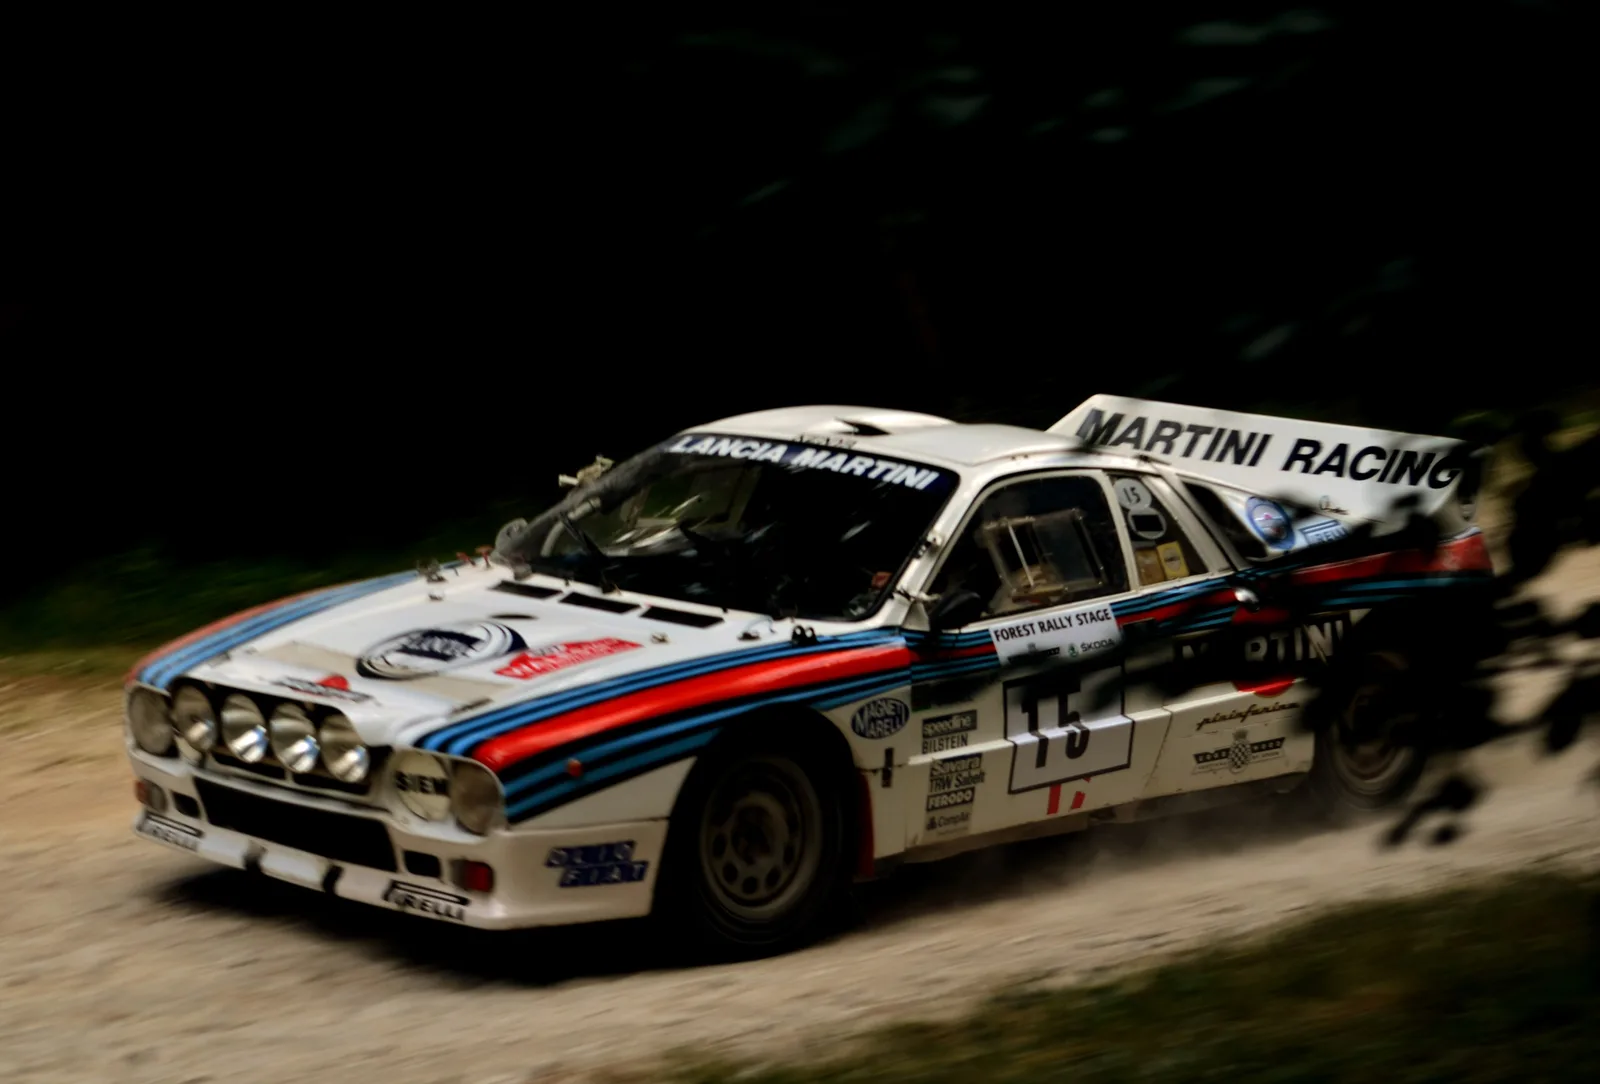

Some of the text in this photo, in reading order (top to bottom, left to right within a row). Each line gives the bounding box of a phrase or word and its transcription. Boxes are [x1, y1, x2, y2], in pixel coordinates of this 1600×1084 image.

[669, 435, 788, 463] LANCIA
[787, 447, 941, 491] MARTINI
[1076, 408, 1464, 489] MARTINI RACING
[1123, 486, 1140, 503] 15
[994, 608, 1111, 642] FOREST RALLY STAGE
[1181, 619, 1345, 663] RTINI
[922, 733, 968, 754] BILSTEIN
[1021, 690, 1090, 768] 15
[927, 788, 973, 809] FERODO
